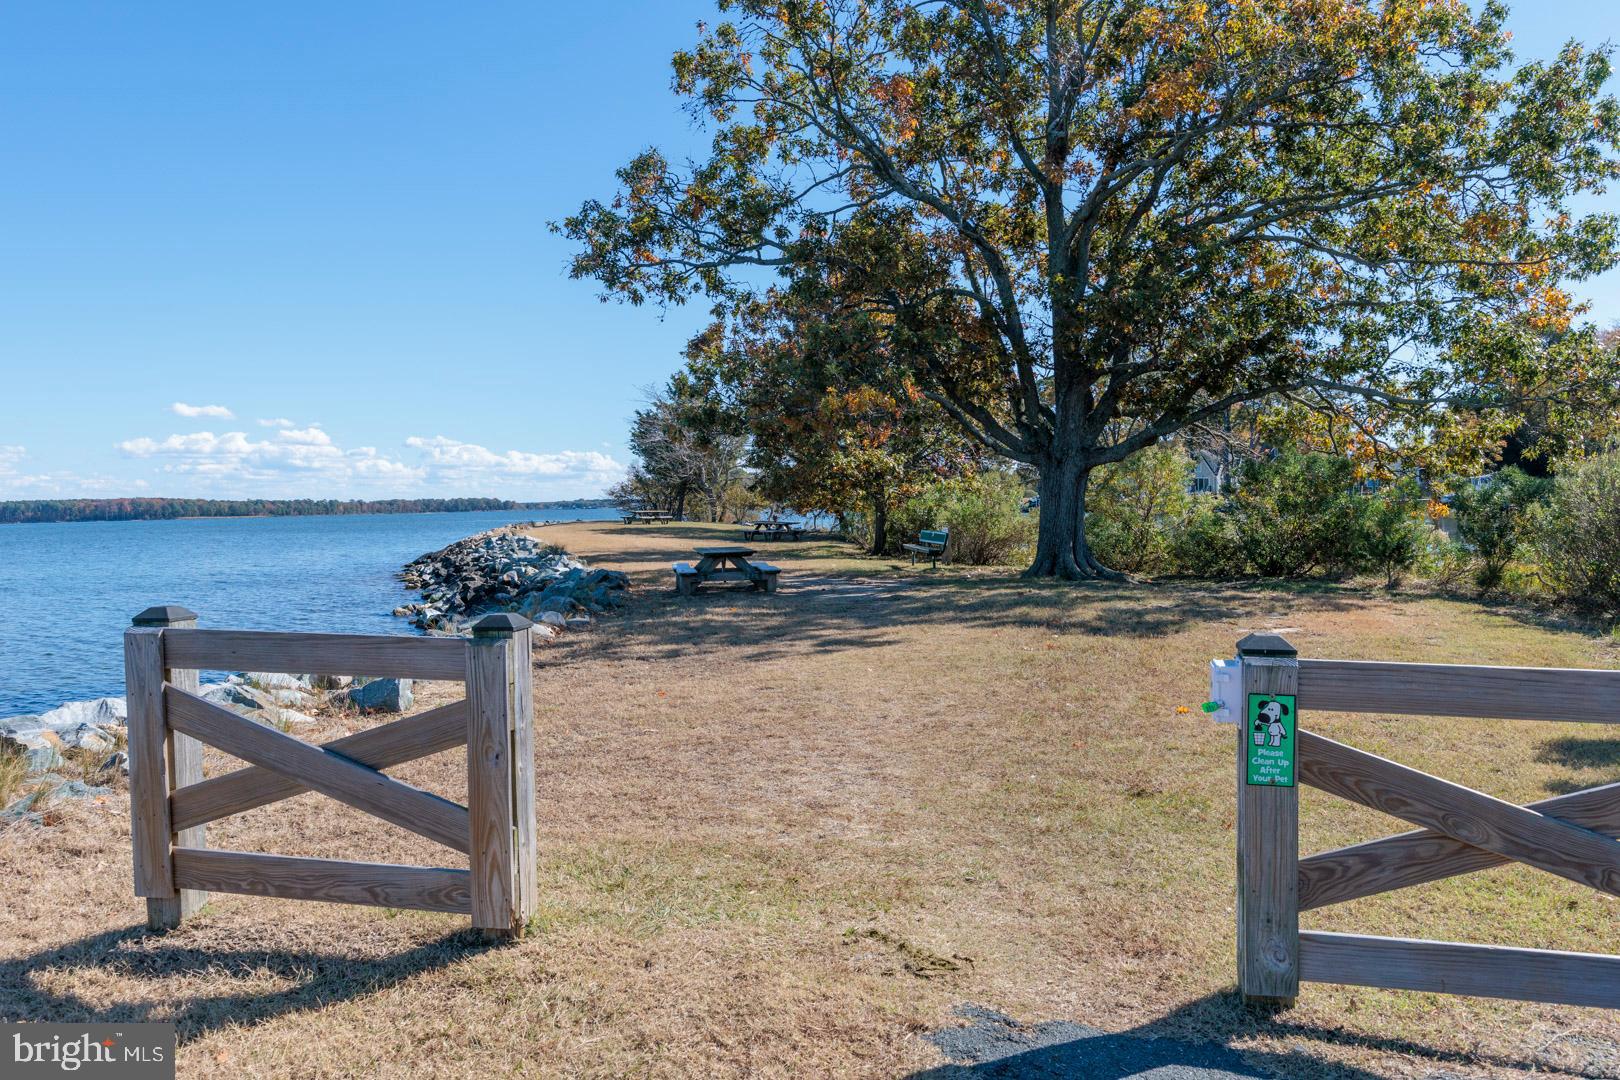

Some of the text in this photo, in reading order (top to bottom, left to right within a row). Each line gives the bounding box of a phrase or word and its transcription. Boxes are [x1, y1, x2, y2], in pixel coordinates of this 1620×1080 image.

[1257, 749, 1284, 757] Please
[1251, 757, 1290, 768] Clean Up
[1260, 766, 1281, 774] After
[1253, 774, 1289, 783] Your Pet
